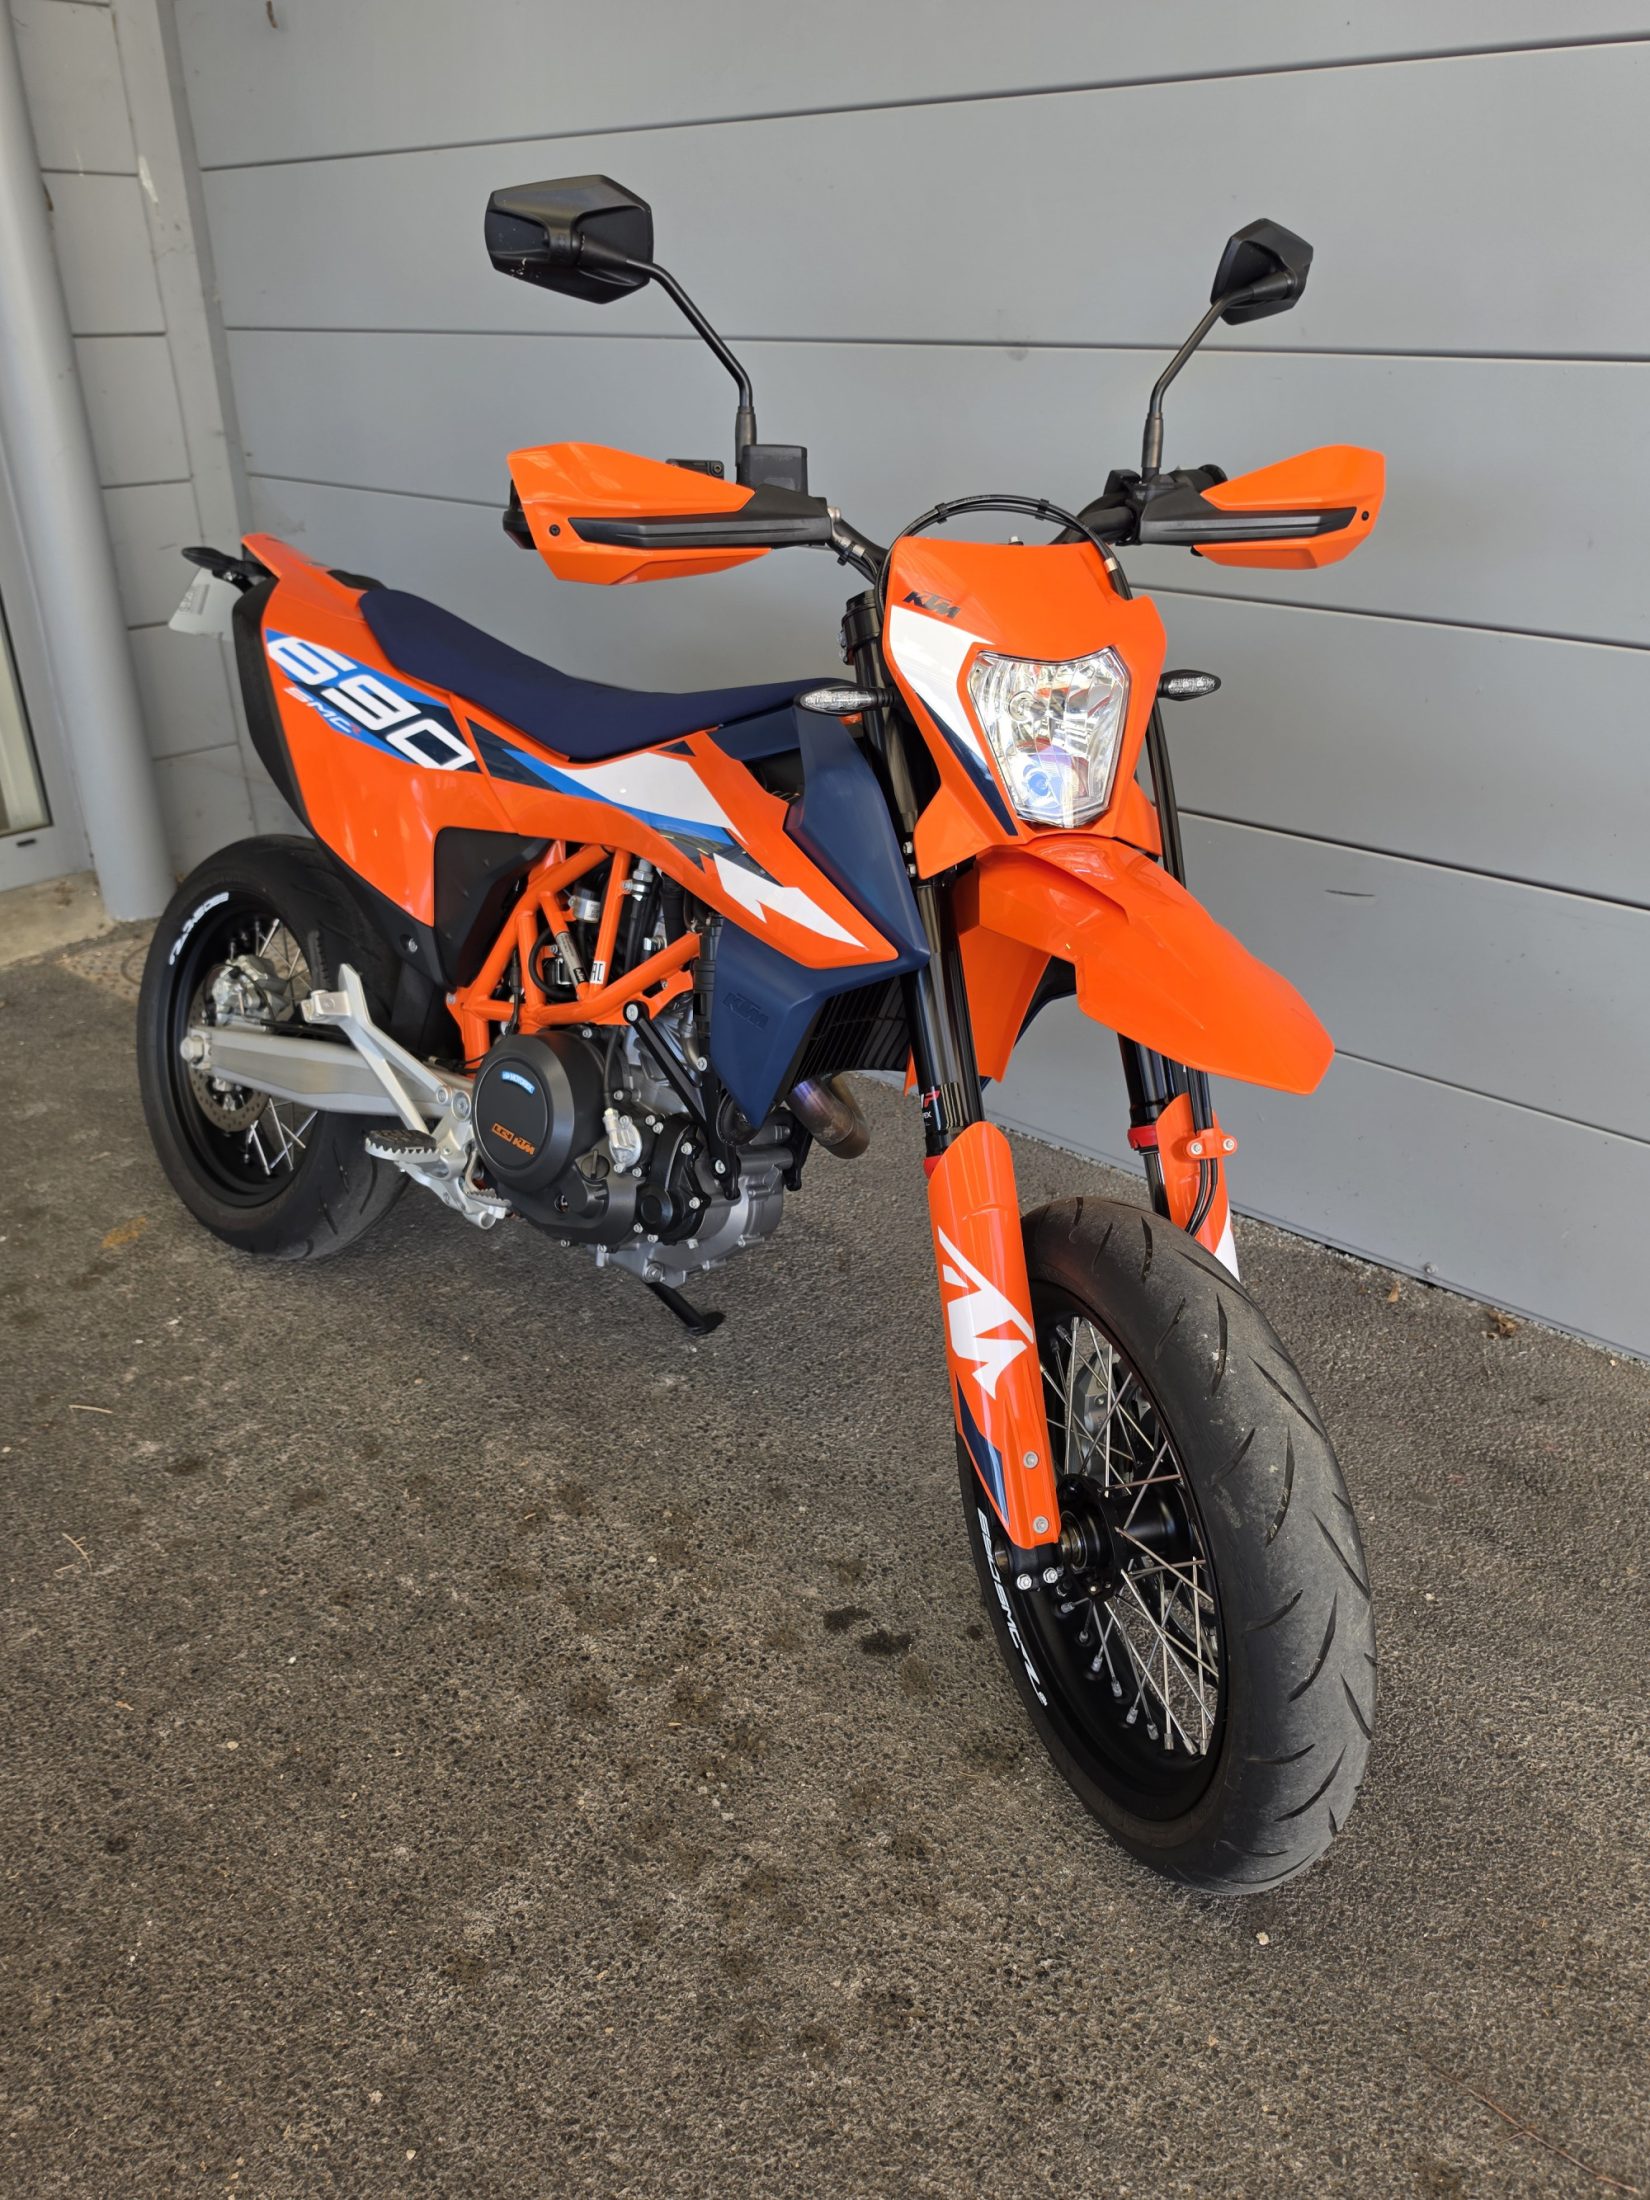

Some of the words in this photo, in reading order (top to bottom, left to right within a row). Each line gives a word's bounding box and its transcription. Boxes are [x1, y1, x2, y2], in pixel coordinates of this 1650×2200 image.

[902, 591, 961, 619] KTM
[268, 636, 476, 771] 690
[721, 992, 769, 1029] KTM
